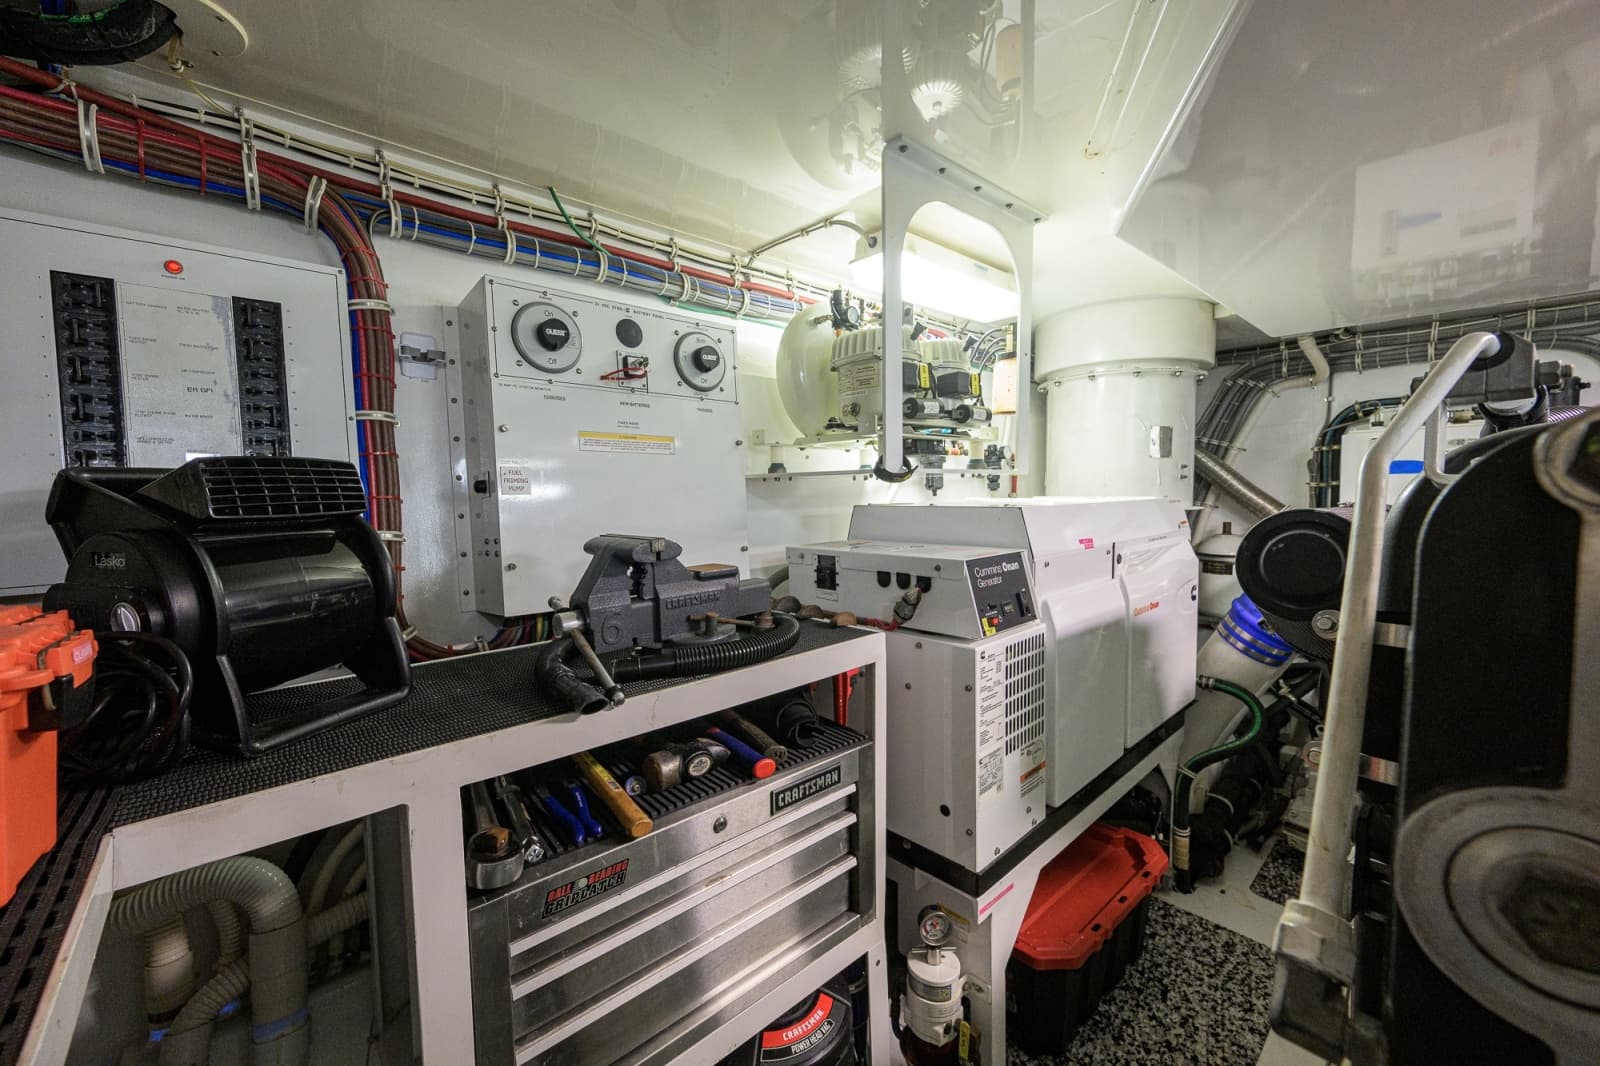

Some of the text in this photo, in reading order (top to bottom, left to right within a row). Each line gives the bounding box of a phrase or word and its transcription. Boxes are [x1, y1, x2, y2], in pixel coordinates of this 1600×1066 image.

[95, 554, 126, 569] Lasko
[974, 562, 1019, 577] Cummins Onan
[977, 576, 1002, 588] Generator
[777, 769, 839, 807] CRAFTSMAN
[544, 870, 627, 916] GRIPLATCH
[547, 858, 628, 905] BALL BEARING
[782, 1008, 825, 1041] CRAFTSMAN
[791, 1021, 831, 1054] POWER HEAD VAC
